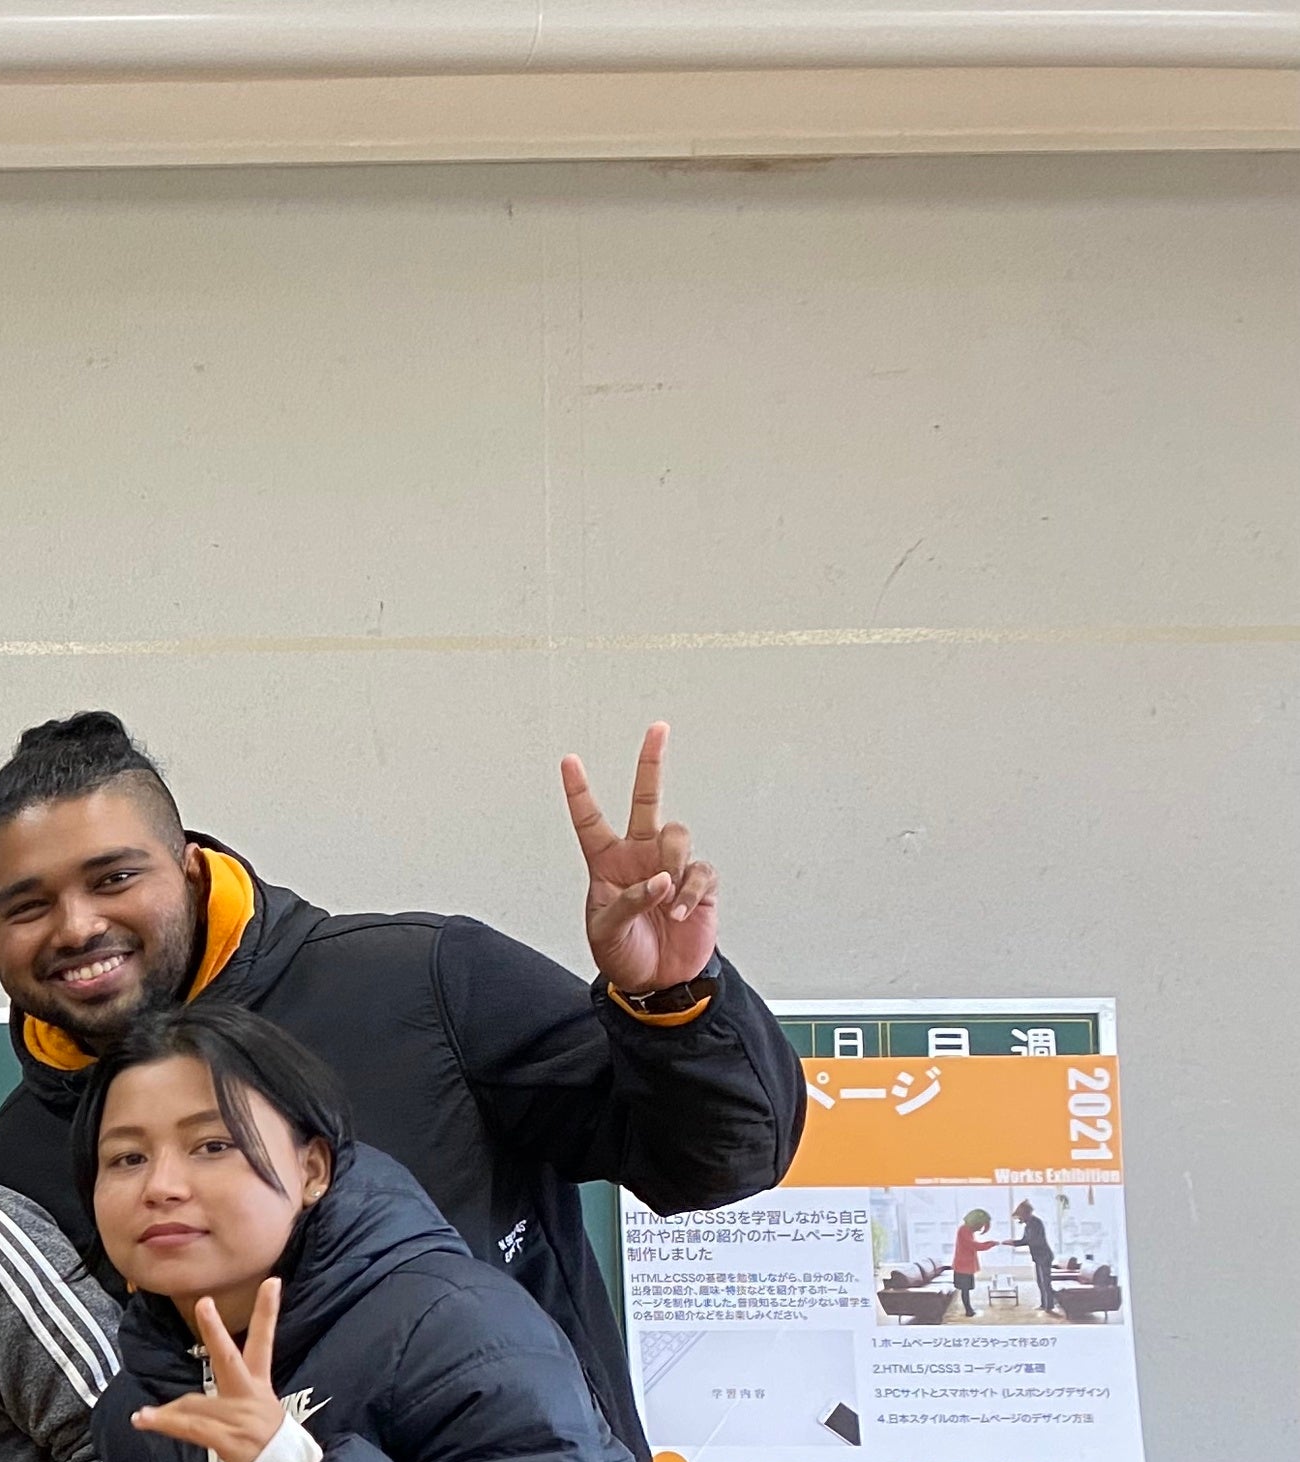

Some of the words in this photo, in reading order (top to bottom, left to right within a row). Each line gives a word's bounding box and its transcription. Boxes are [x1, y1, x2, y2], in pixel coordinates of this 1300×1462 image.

[1067, 1067, 1114, 1160] 2021
[995, 1168, 1043, 1184] Works
[1046, 1168, 1120, 1184] Exhibition
[626, 1229, 865, 1243] 紹介や店舗の紹介のホームページを
[627, 1247, 713, 1262] 制作しました
